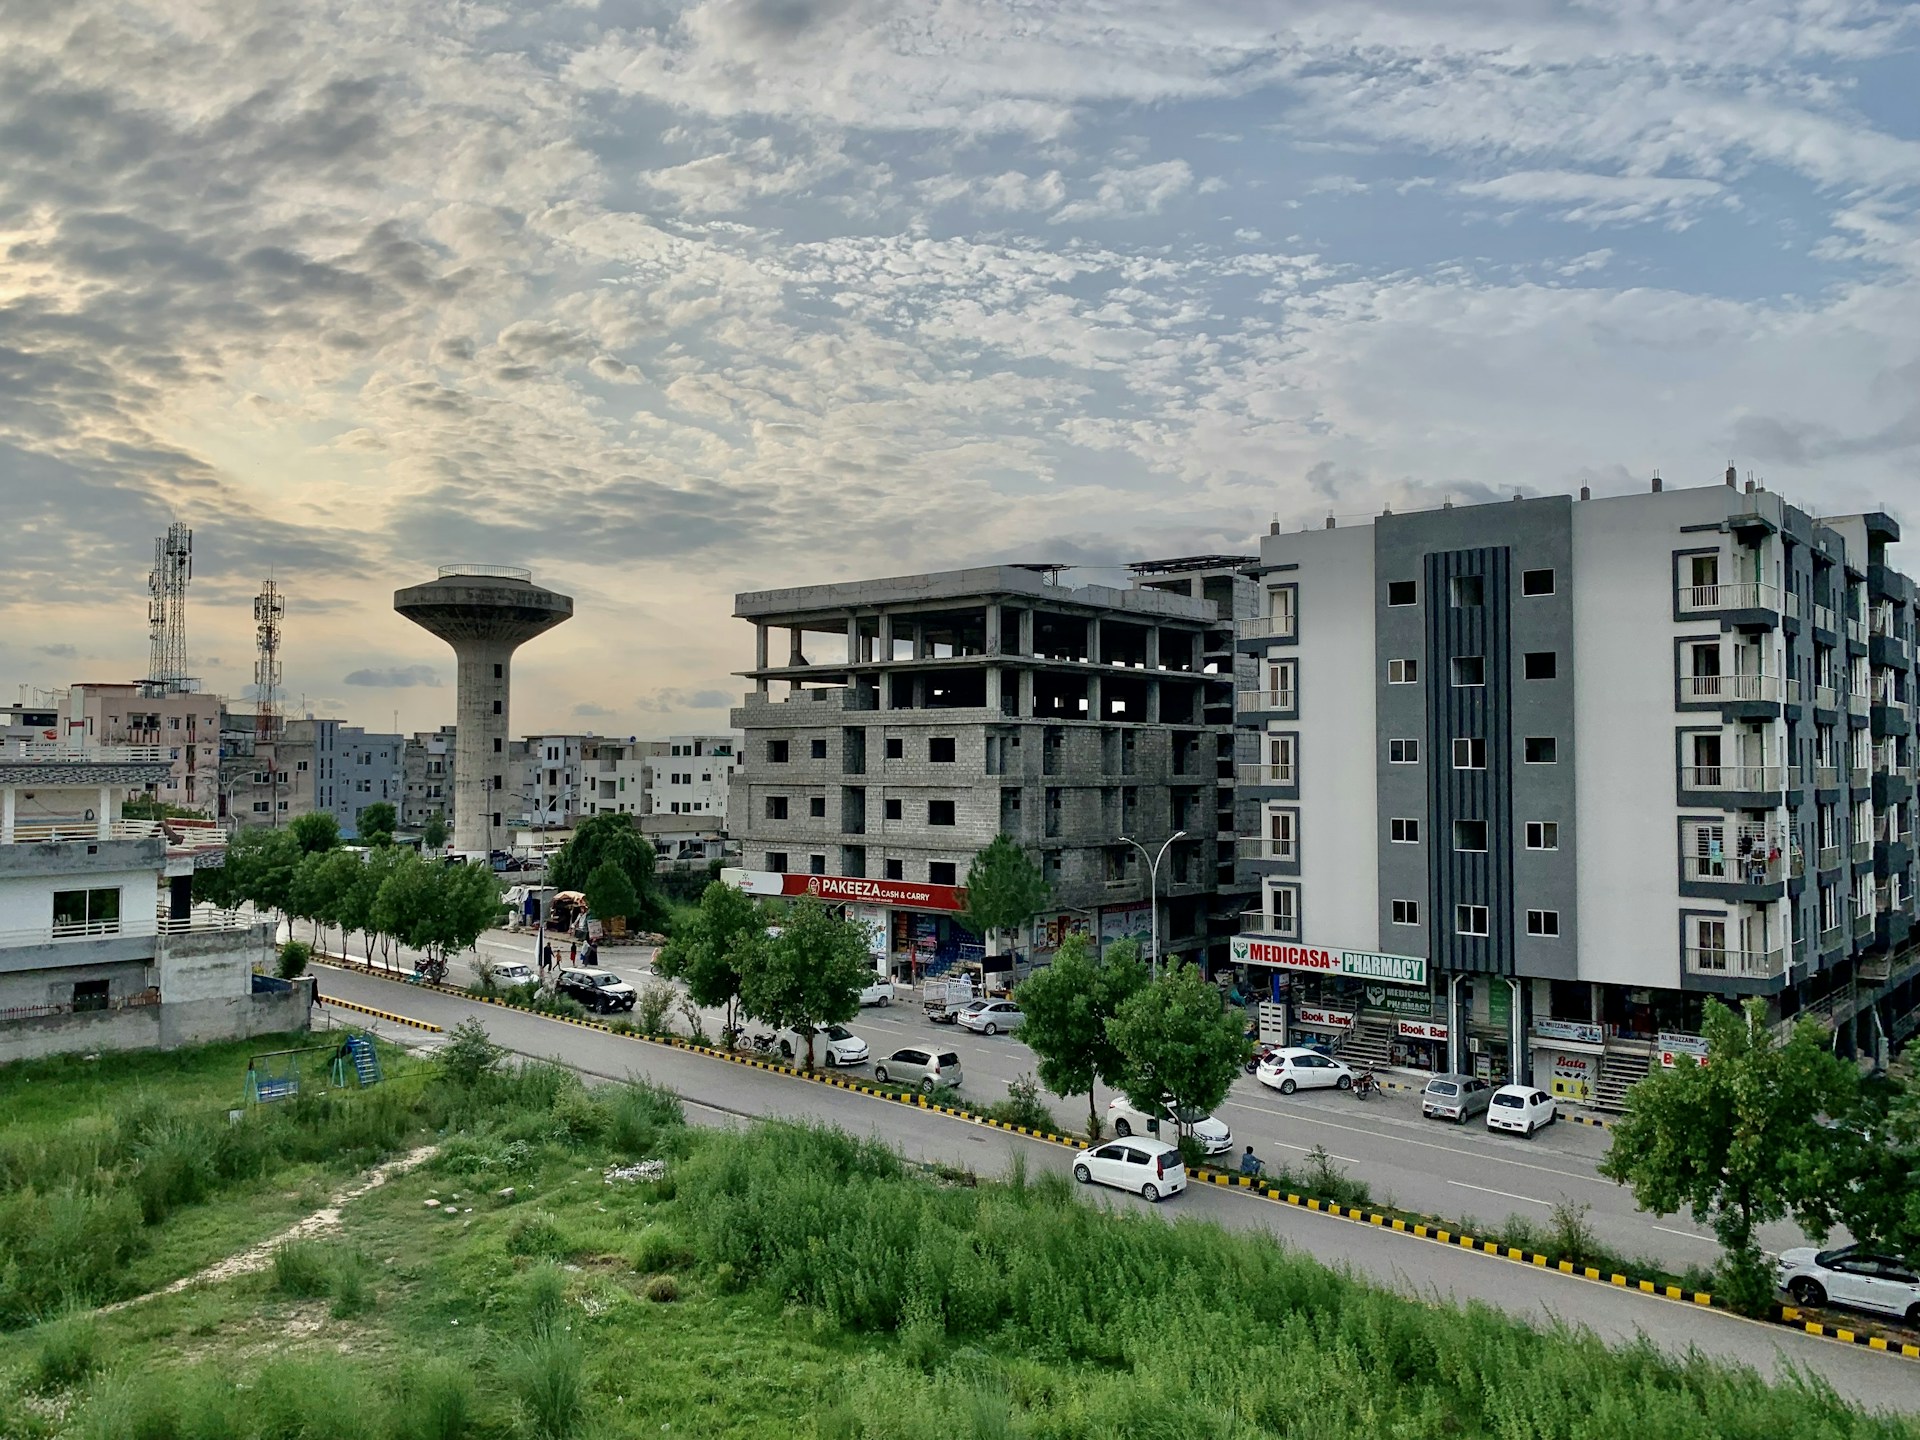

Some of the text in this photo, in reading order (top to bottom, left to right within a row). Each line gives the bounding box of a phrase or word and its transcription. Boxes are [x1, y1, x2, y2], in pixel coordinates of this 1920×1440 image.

[822, 879, 880, 897] PAKEEZA
[881, 889, 898, 899] CASH
[906, 891, 930, 902] CARRY
[1250, 943, 1330, 969] MEDICASA
[1344, 954, 1422, 980] PHARMACY
[1386, 988, 1430, 1000] MEDICASA
[1301, 1010, 1351, 1025] Book Bank
[1400, 1023, 1448, 1038] Book Ban
[1668, 1036, 1699, 1044] MUZZAMIL
[1556, 1055, 1586, 1069] Bata
